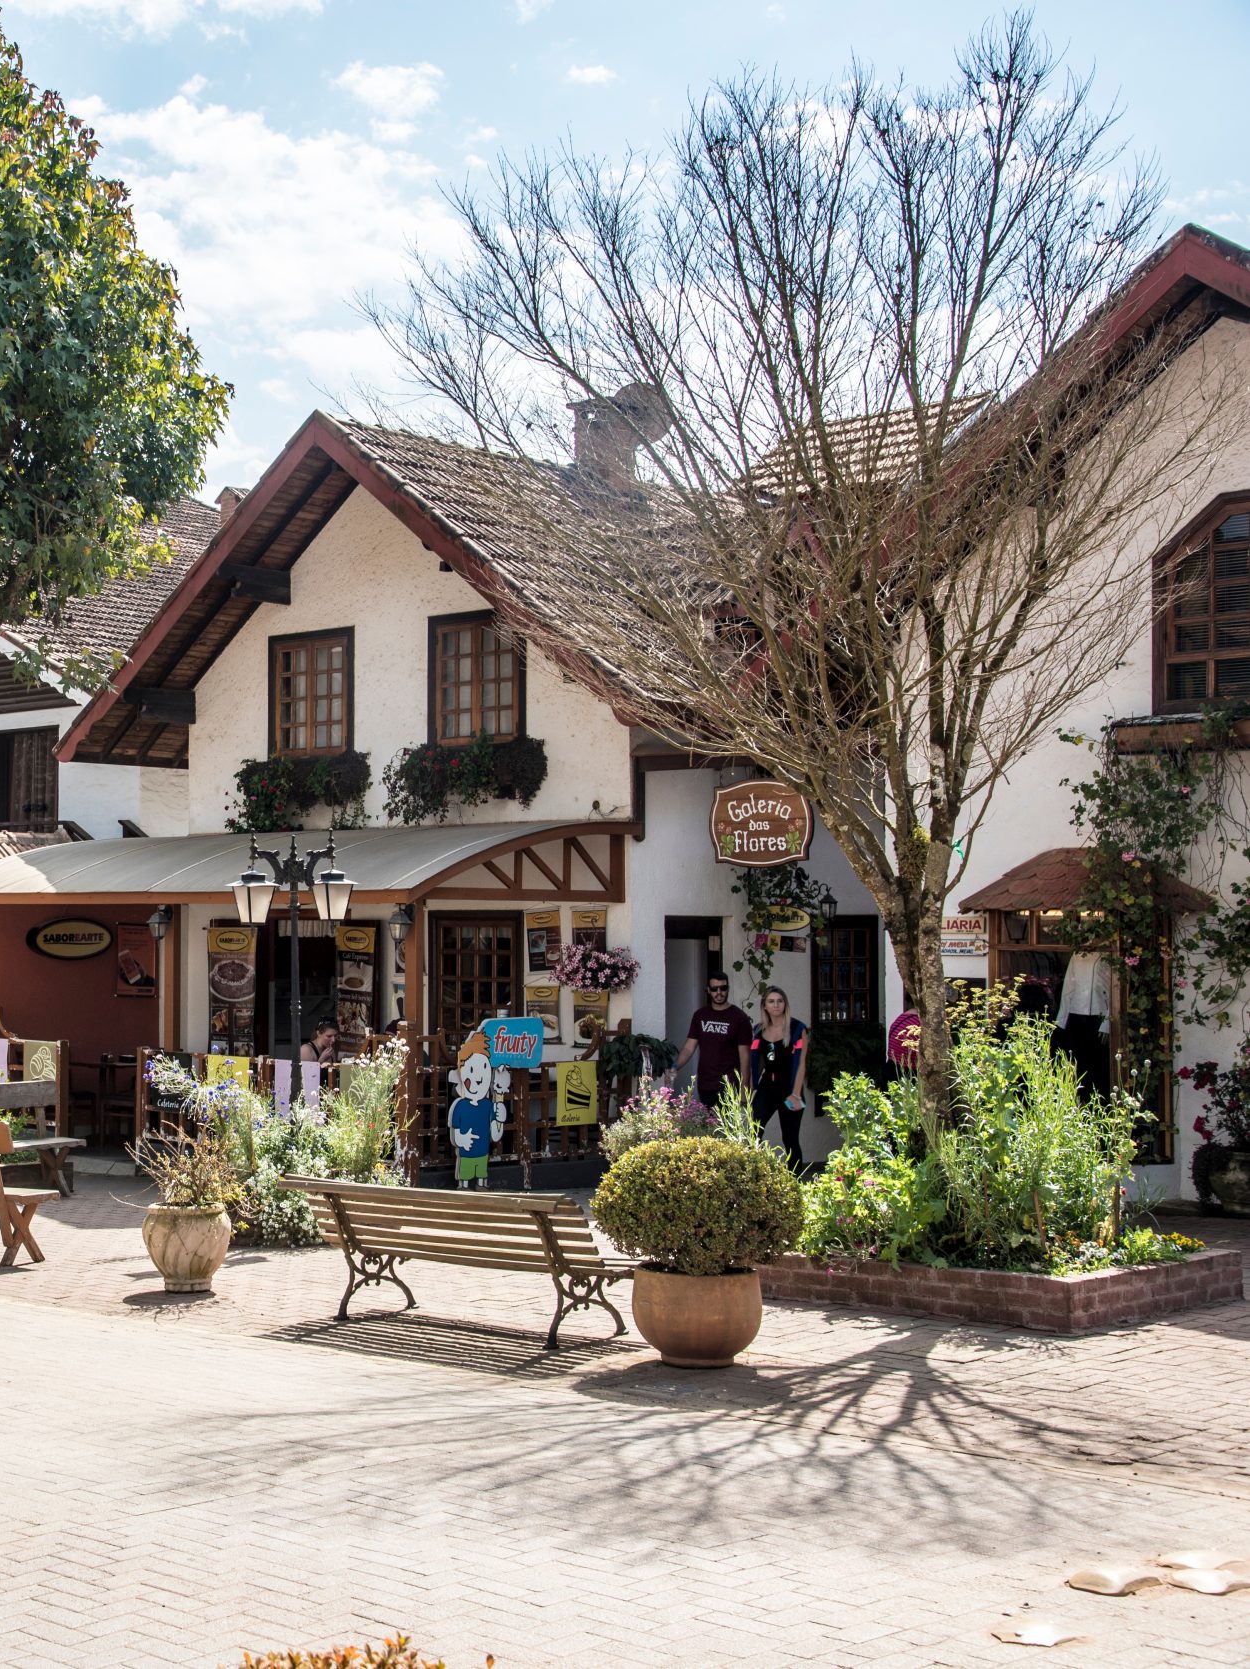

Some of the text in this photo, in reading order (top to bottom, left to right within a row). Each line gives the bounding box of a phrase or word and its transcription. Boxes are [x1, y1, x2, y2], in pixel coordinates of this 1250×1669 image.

[727, 793, 792, 822] Galeria
[749, 819, 770, 831] das
[733, 829, 787, 853] Flores
[701, 1020, 729, 1034] VANS
[494, 1026, 538, 1058] fruity
[157, 1099, 180, 1109] Cafeteria
